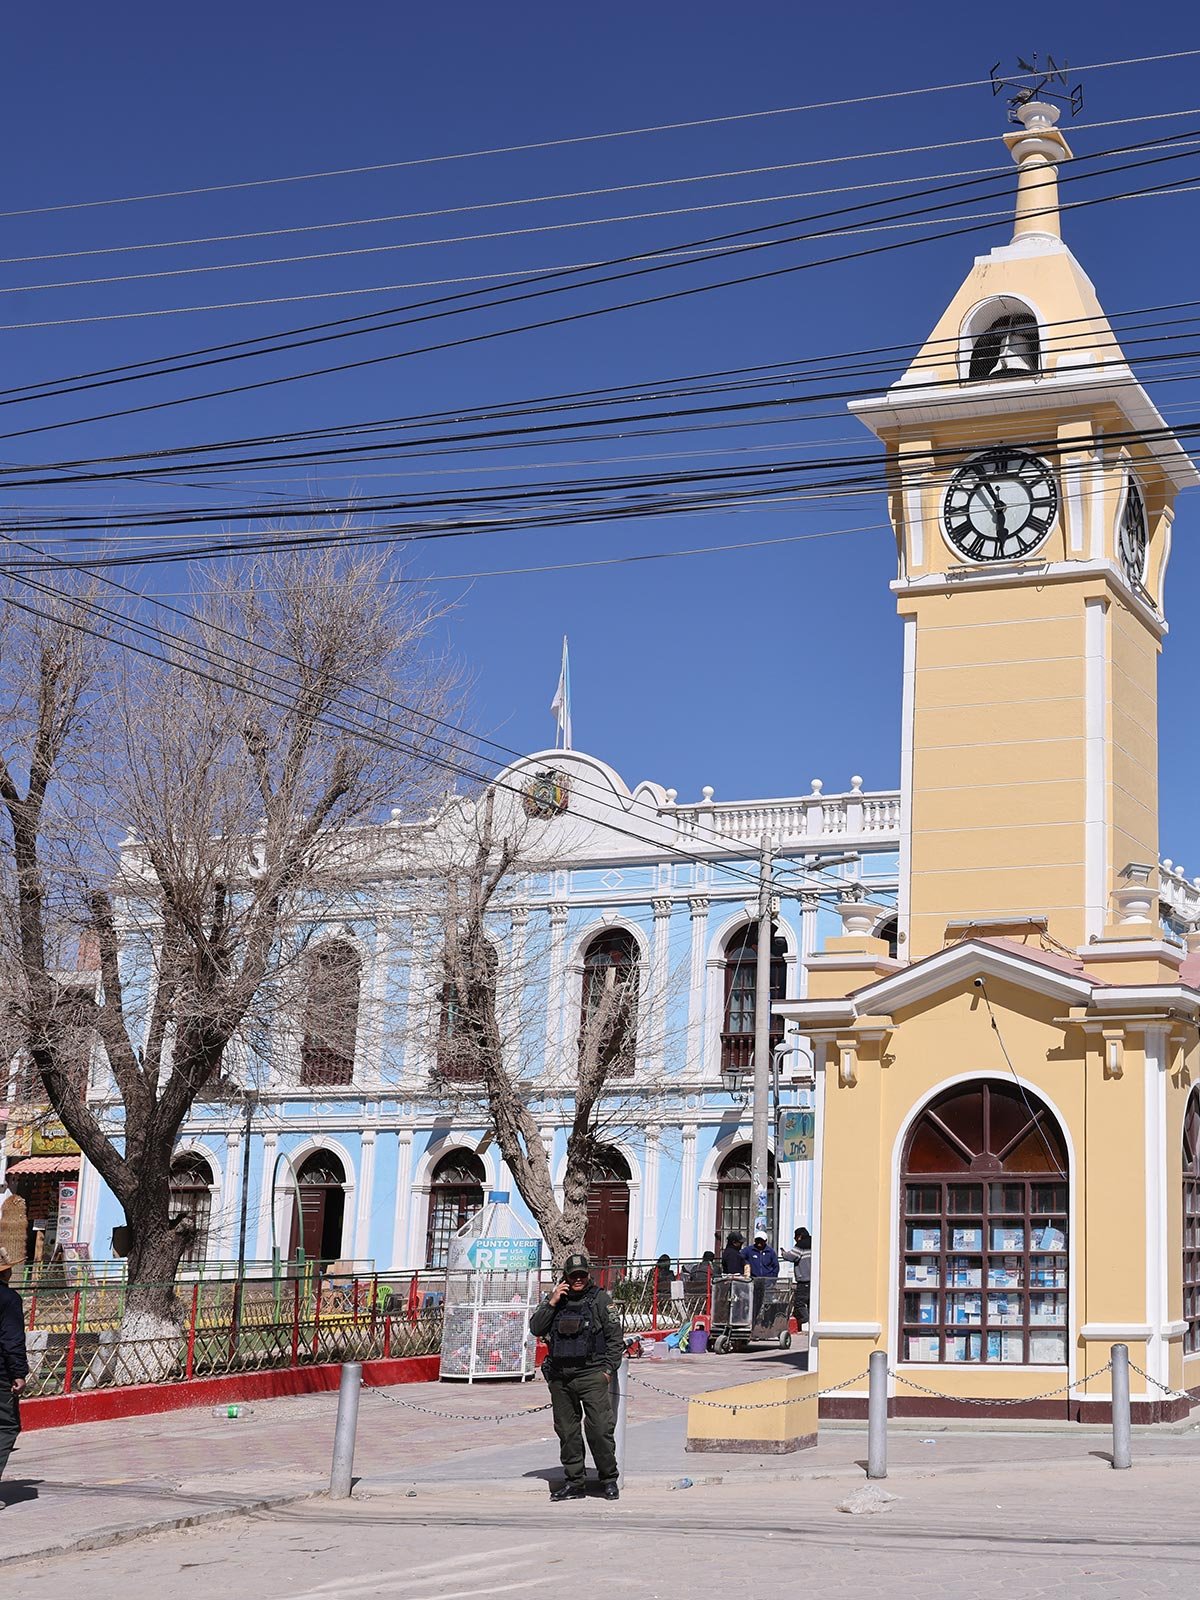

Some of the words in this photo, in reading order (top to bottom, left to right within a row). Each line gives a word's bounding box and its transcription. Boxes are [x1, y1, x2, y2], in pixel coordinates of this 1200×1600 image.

[790, 1140, 807, 1156] Info
[476, 1240, 510, 1248] PUNTO
[513, 1240, 538, 1248] VERDE
[475, 1248, 509, 1268] RE
